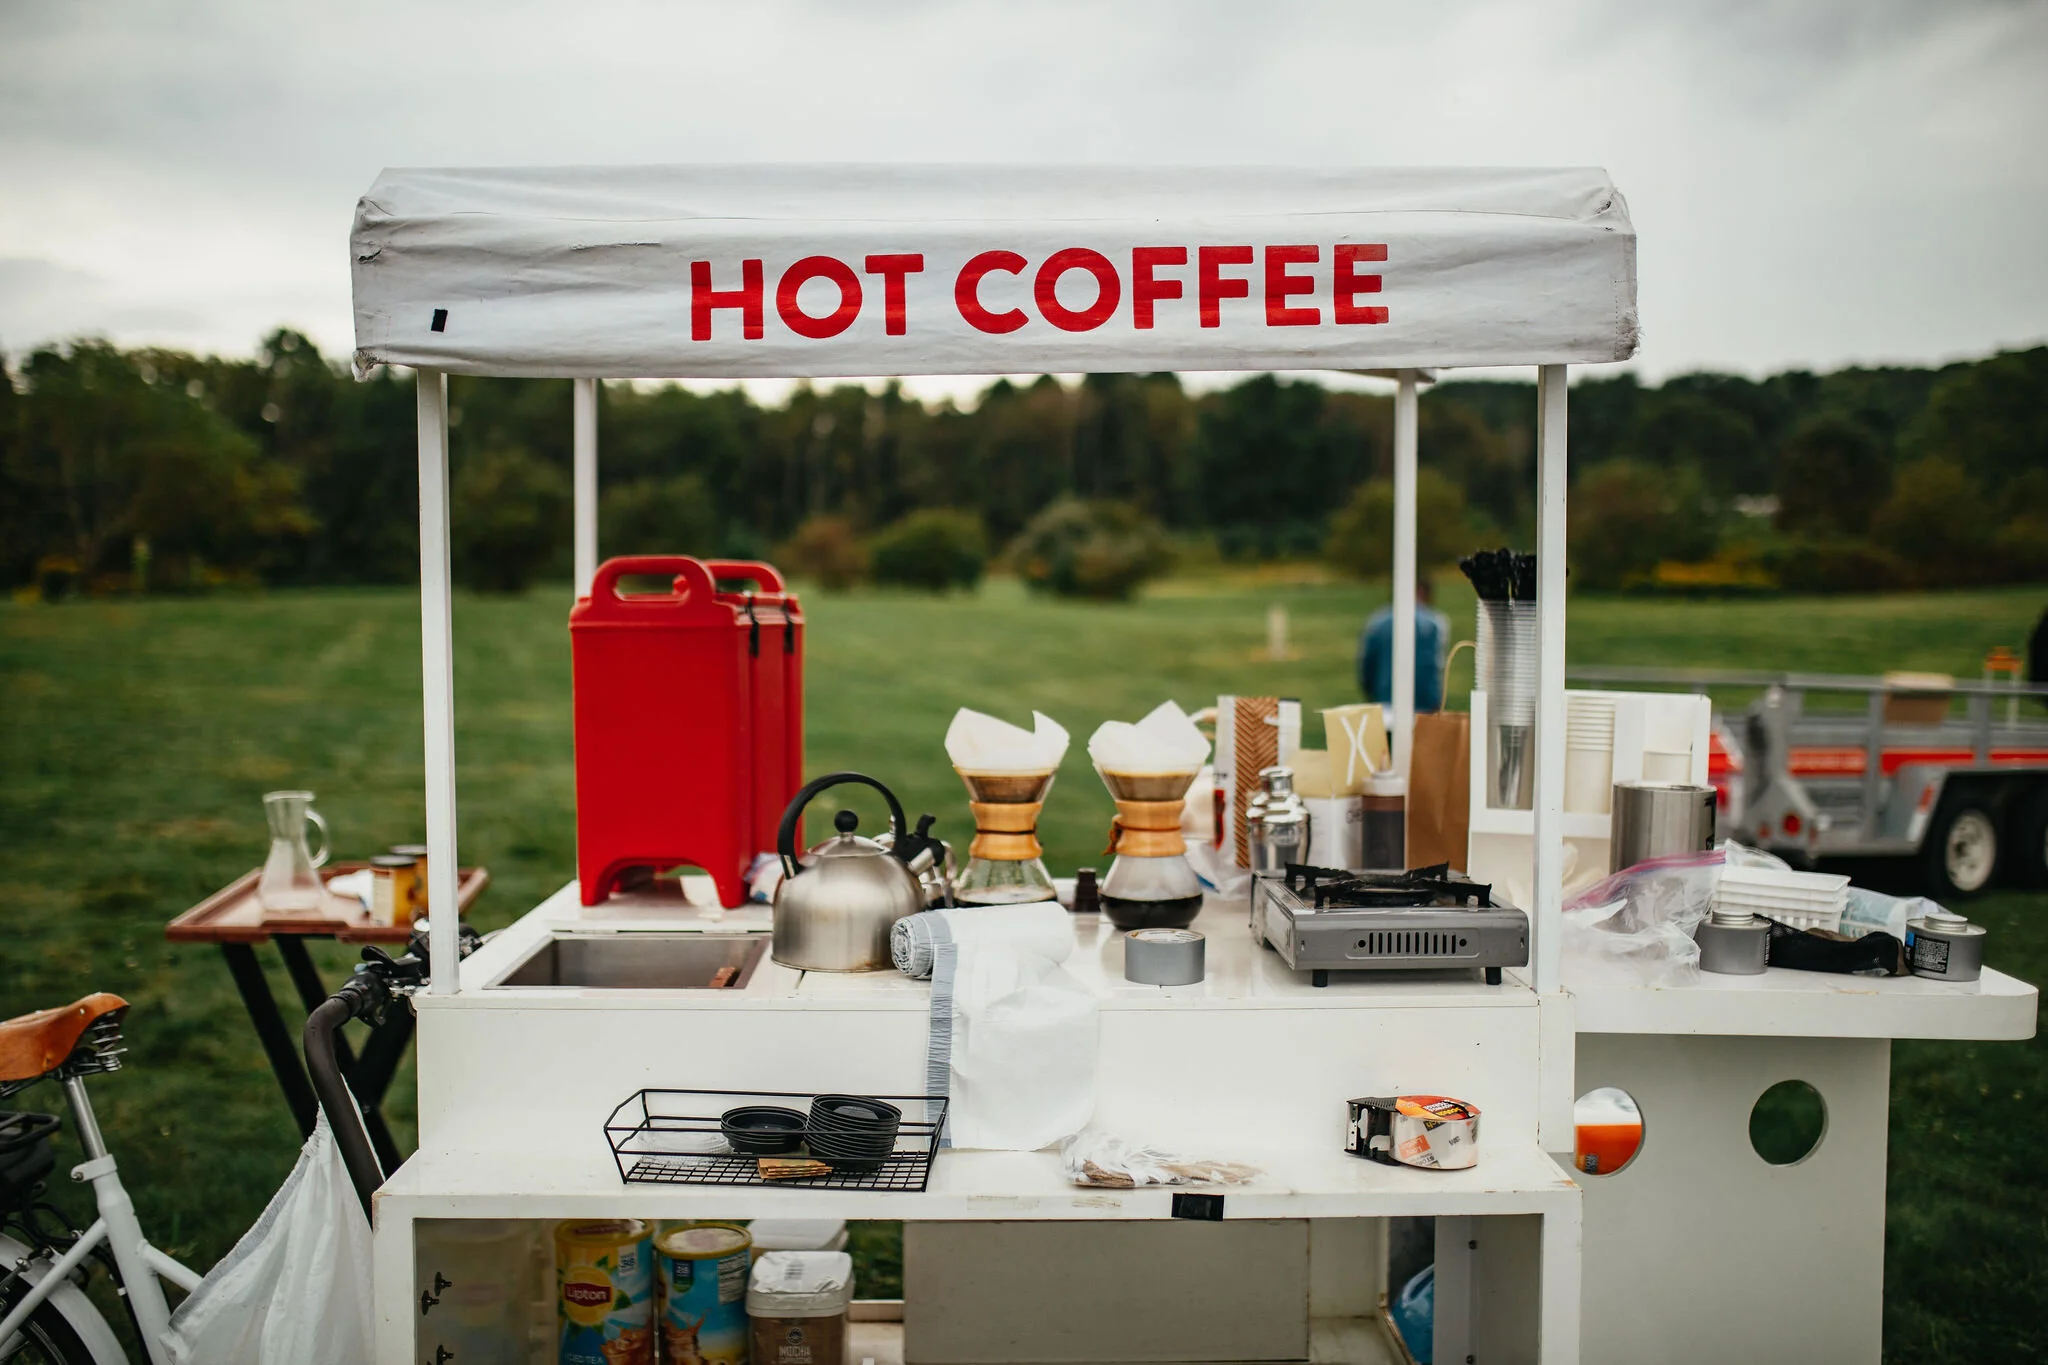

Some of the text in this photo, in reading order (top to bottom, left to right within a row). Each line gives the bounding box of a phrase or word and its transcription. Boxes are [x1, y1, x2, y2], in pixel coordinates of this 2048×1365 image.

[691, 244, 1388, 341] HOT COFFEE
[566, 1286, 607, 1302] Lipton
